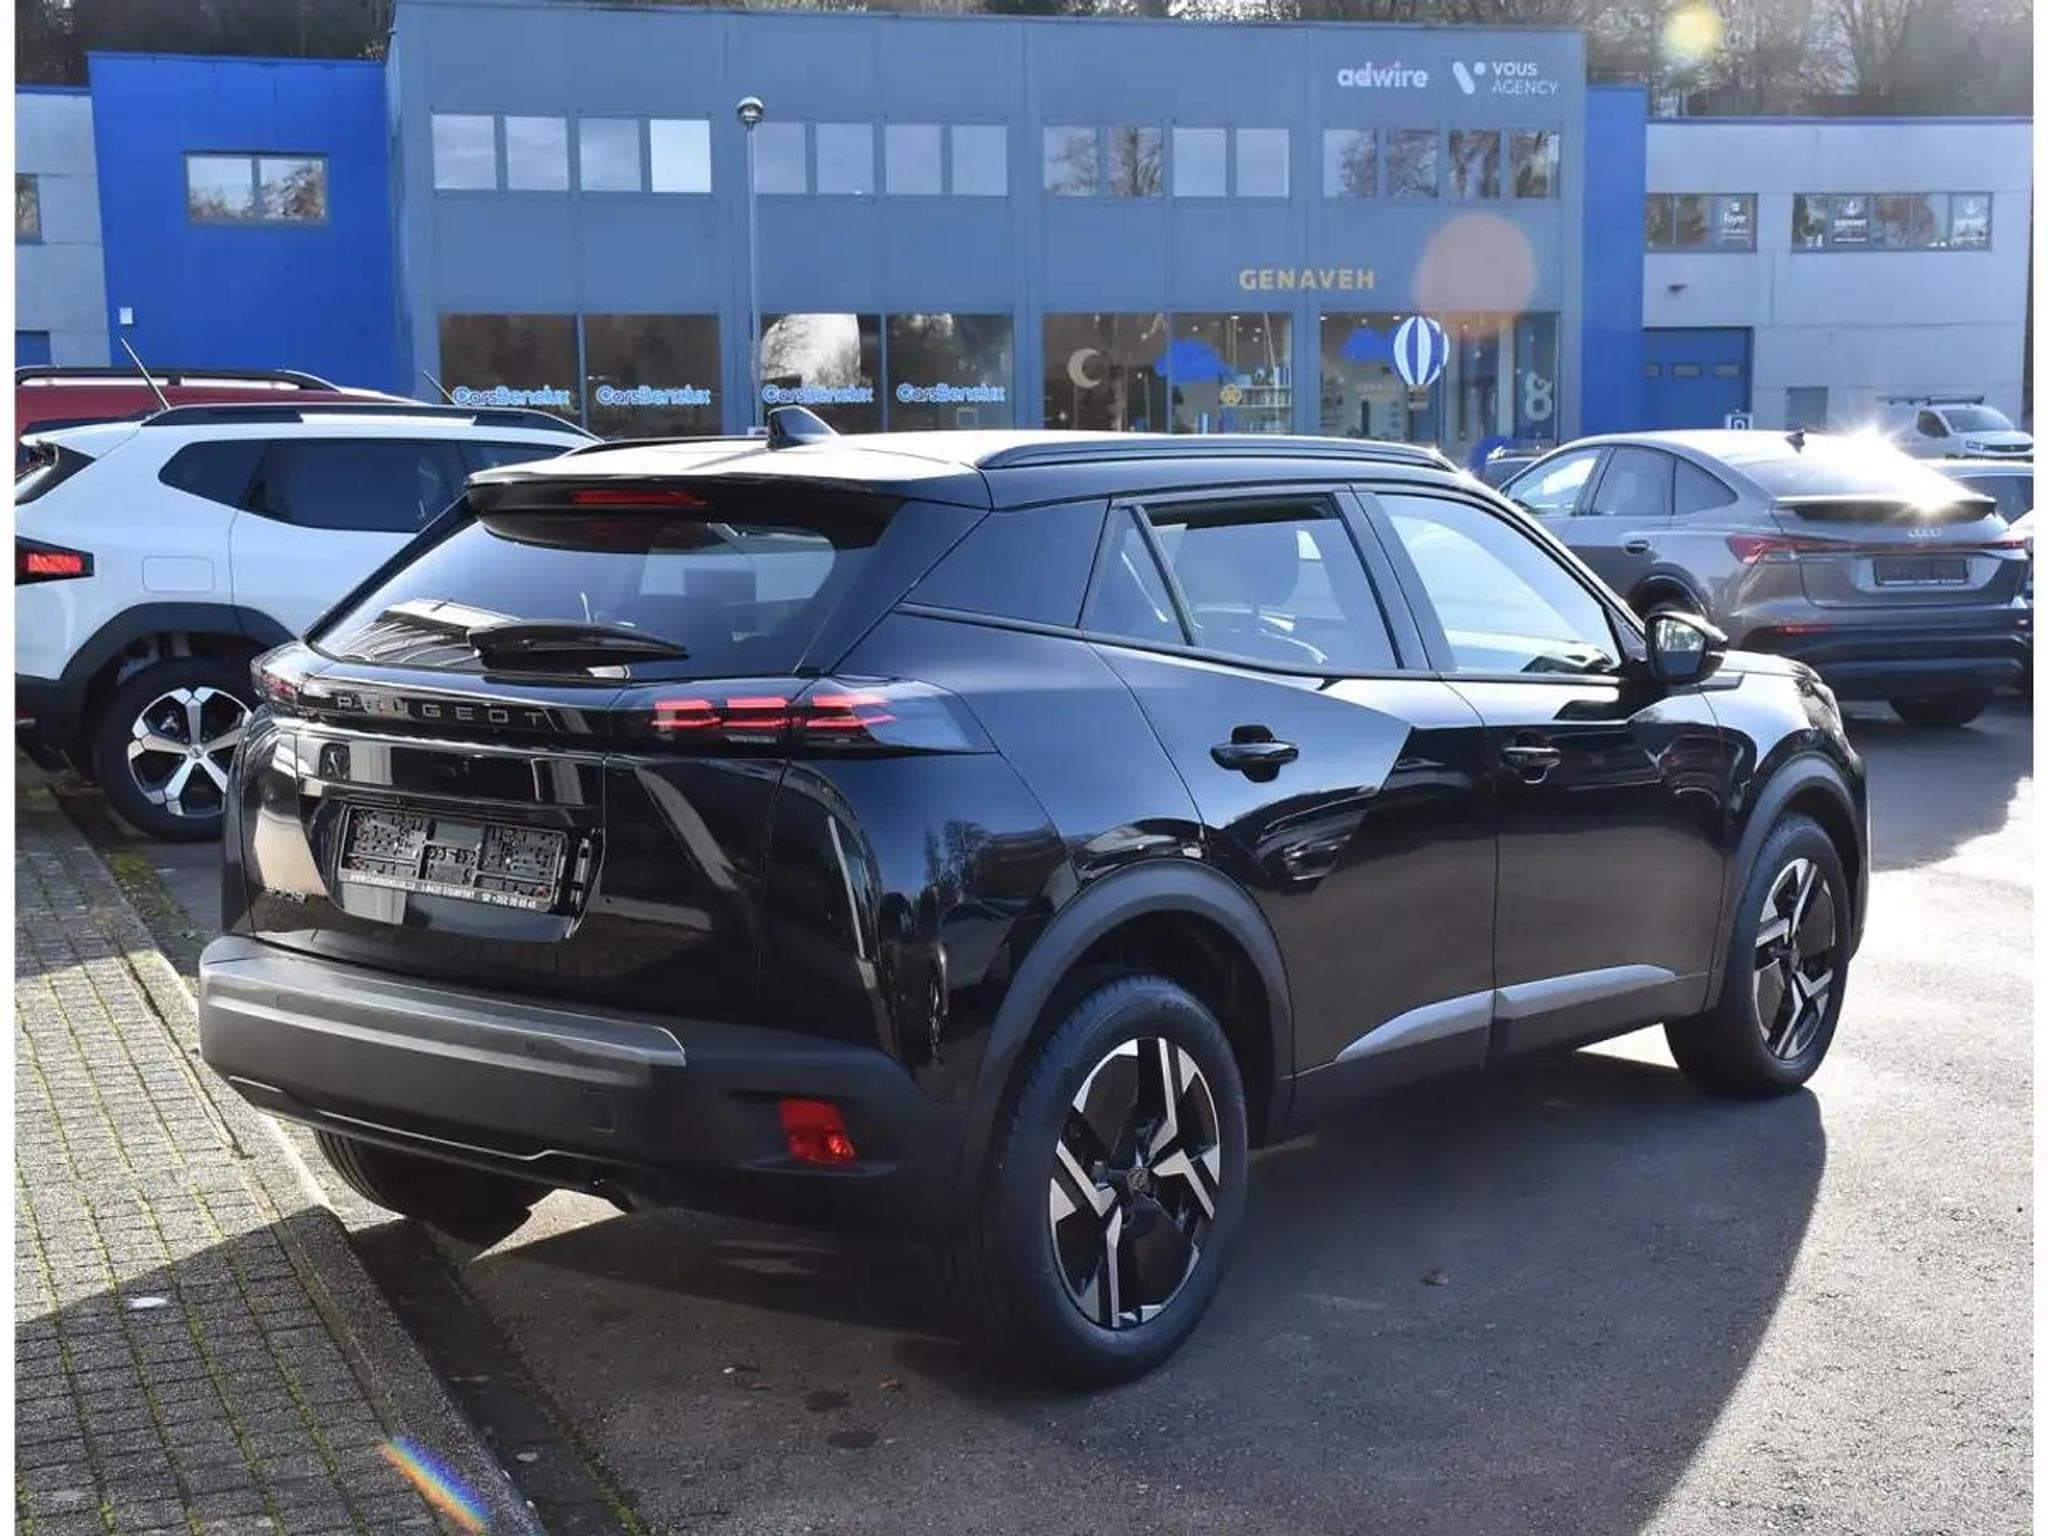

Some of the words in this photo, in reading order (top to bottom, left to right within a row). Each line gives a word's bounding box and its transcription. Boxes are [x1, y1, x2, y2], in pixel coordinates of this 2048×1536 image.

[1337, 61, 1429, 88] adwire
[1492, 61, 1538, 76] VOUS
[1492, 80, 1559, 95] AGENCY
[1239, 268, 1375, 290] GENAVEH
[452, 385, 570, 406] CarsBenelux
[595, 385, 711, 406] CarsBenelux
[762, 384, 873, 404] CarsBenelux
[896, 383, 1005, 403] CarsBenelux
